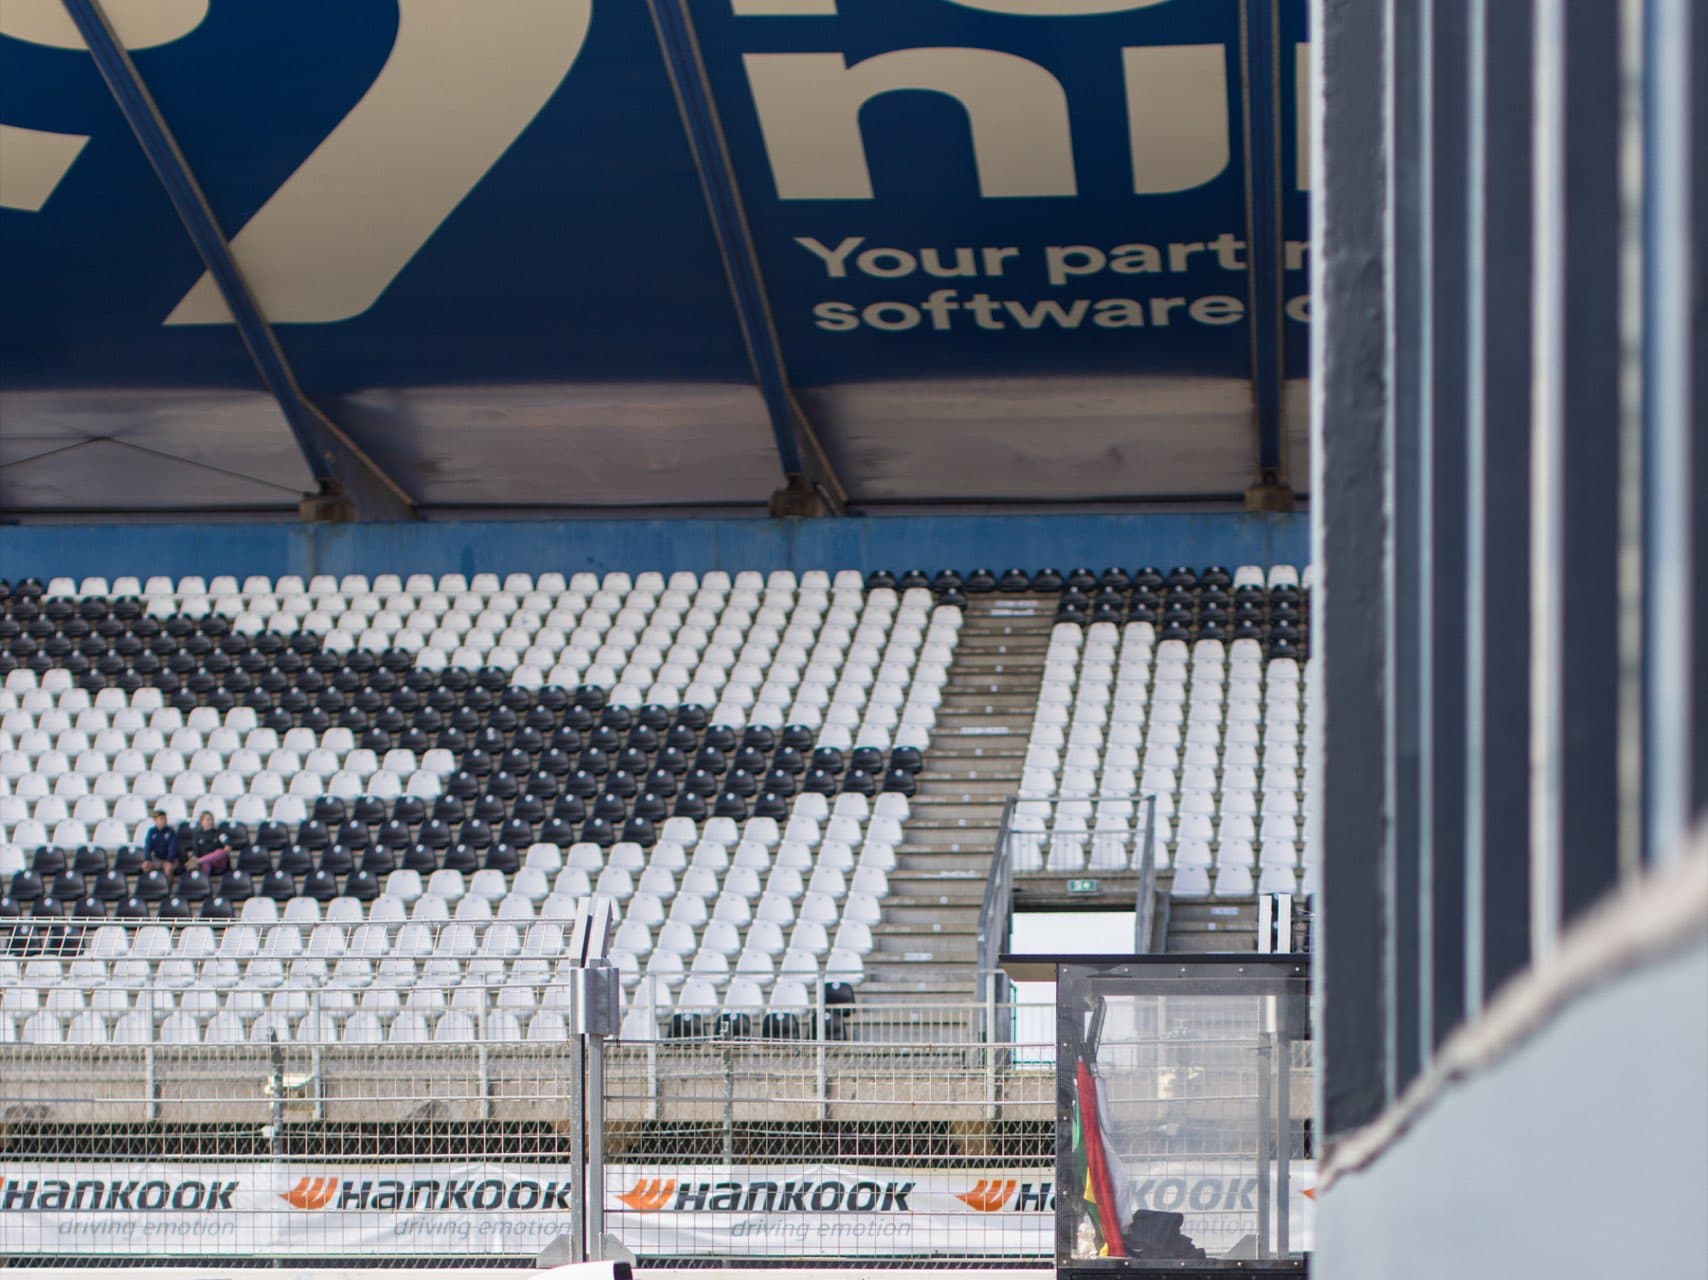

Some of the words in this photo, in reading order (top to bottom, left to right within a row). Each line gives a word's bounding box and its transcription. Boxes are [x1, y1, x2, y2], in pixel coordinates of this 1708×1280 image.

[794, 236, 1019, 278] Your
[813, 290, 1246, 332] software
[58, 1218, 136, 1241] driving
[143, 1220, 235, 1237] emotion
[393, 1217, 470, 1241] driving
[478, 1219, 571, 1236] emotion
[731, 1219, 809, 1242] driving
[817, 1221, 911, 1238] emotion
